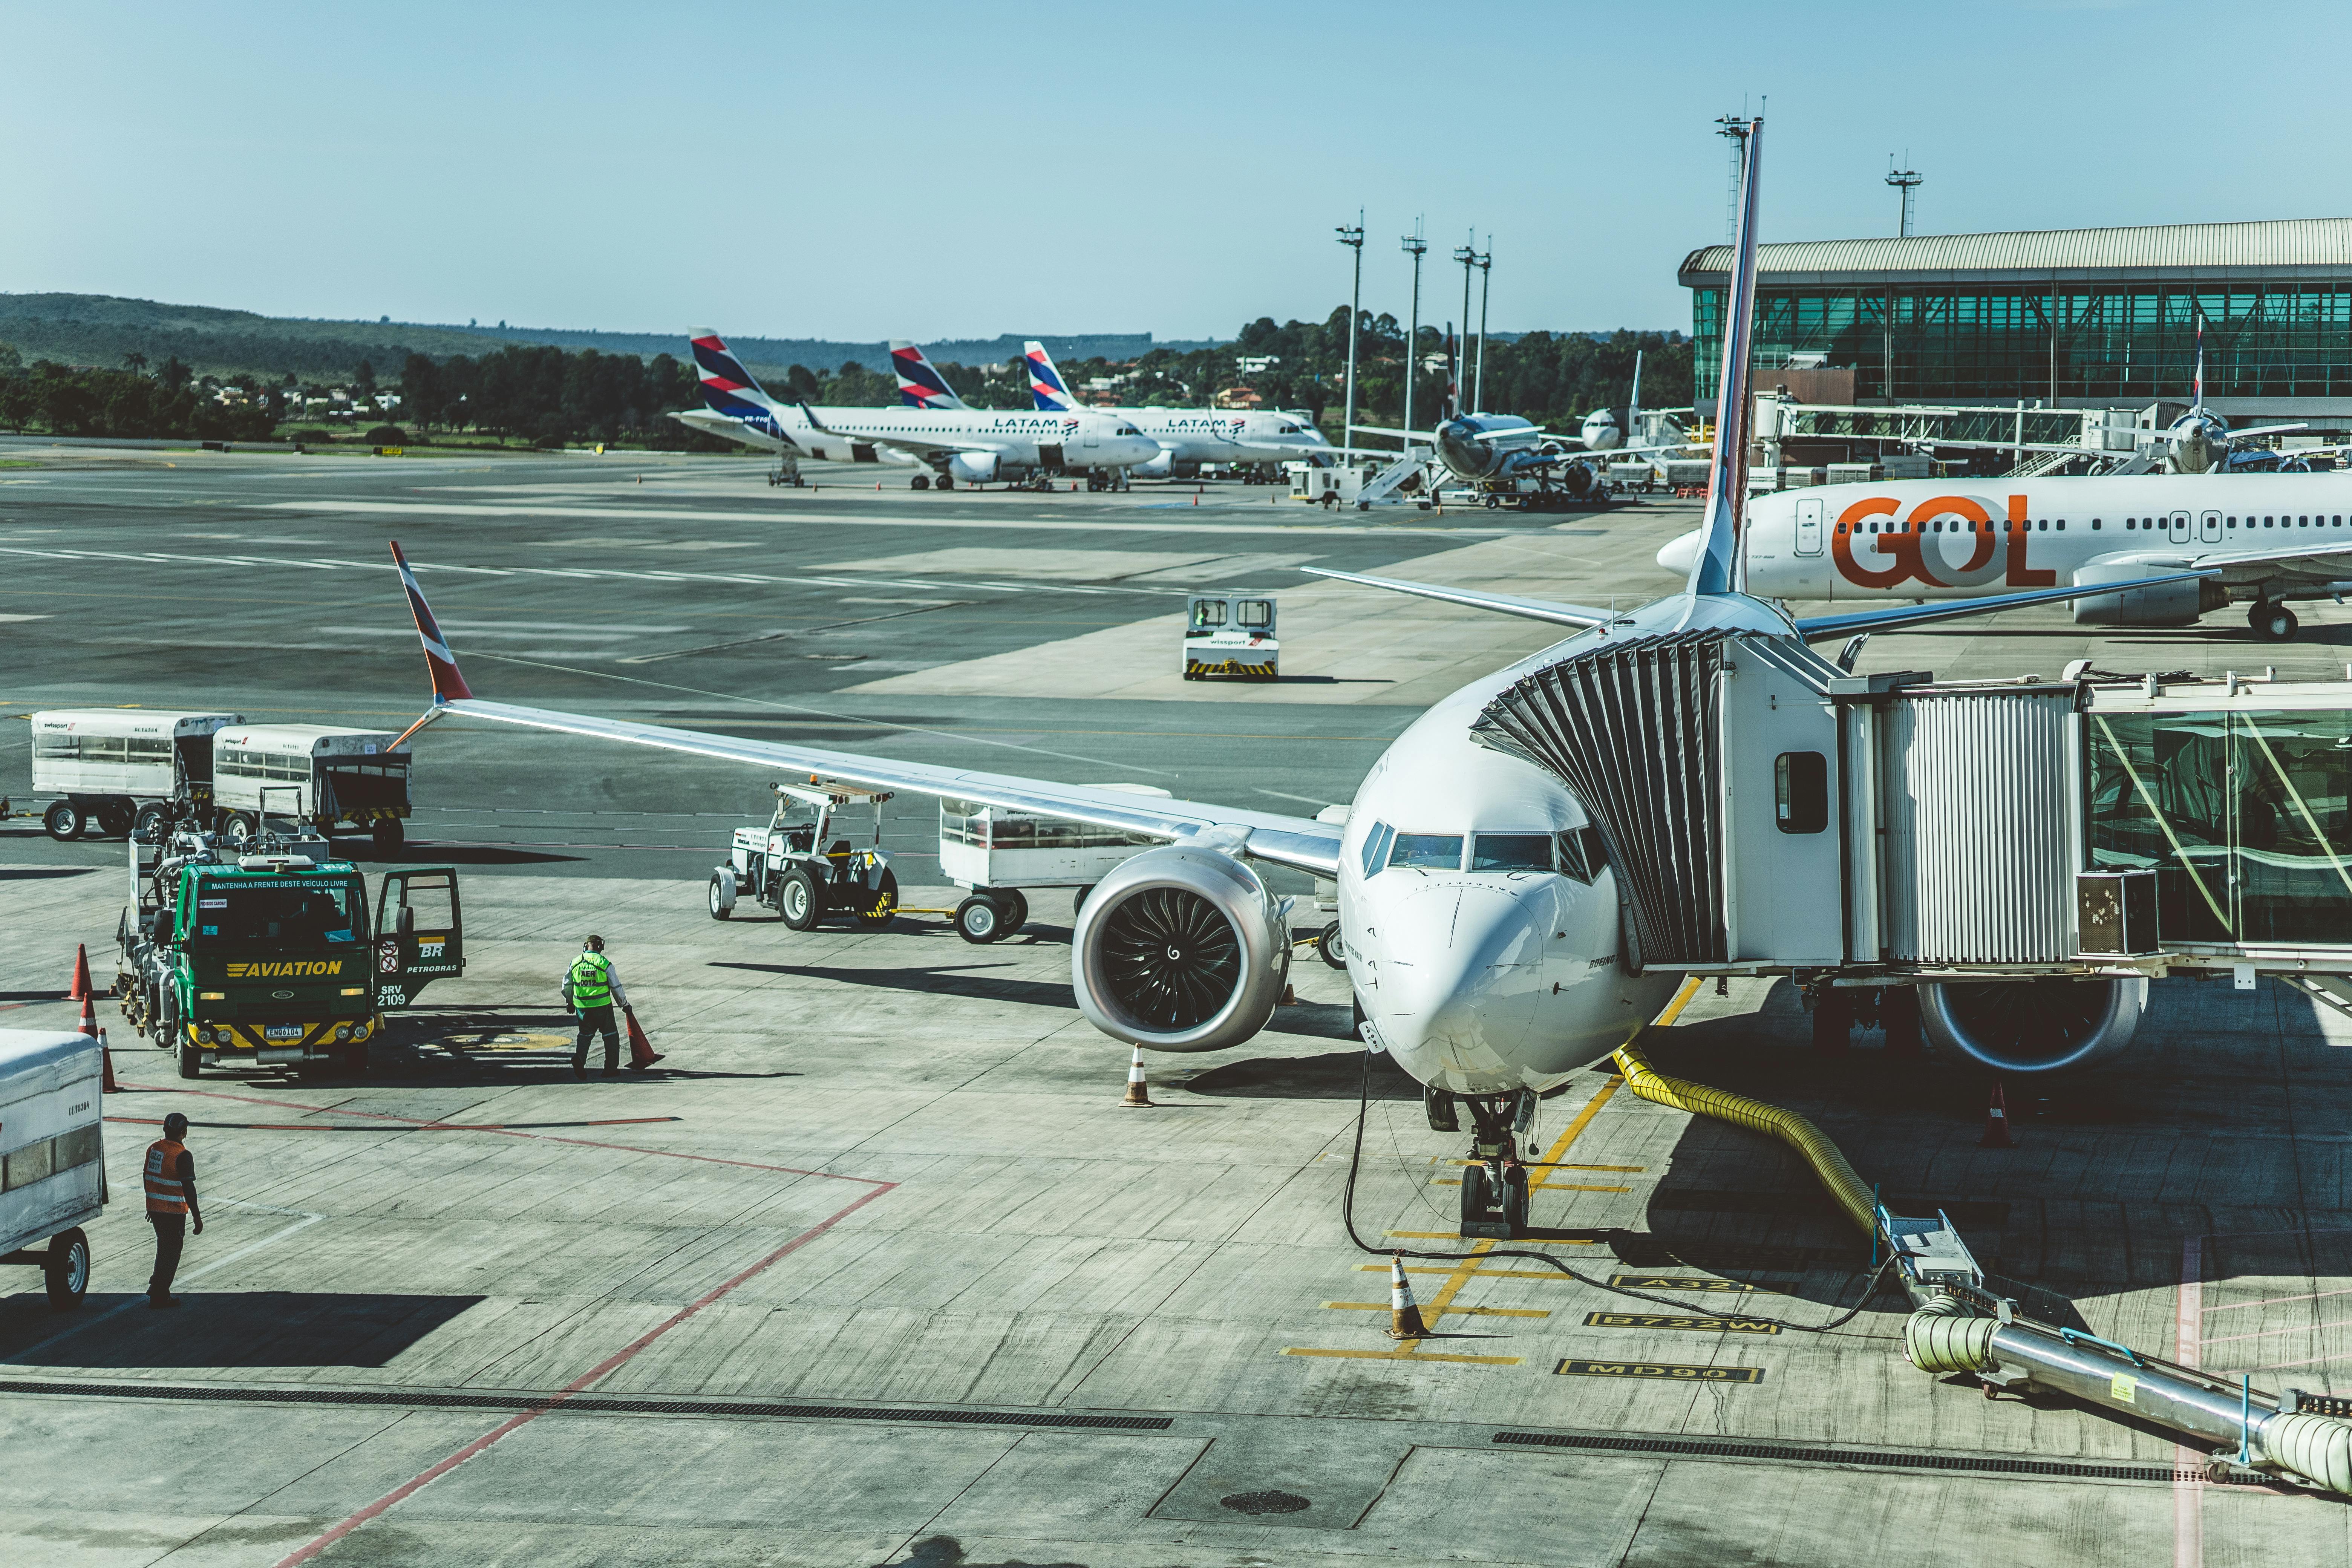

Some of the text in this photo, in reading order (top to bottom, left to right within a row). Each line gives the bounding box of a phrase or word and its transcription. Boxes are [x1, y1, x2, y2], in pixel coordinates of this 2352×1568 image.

[995, 418, 1057, 427] LATAM
[1832, 495, 2056, 588] GOL
[421, 945, 443, 958] BR
[1588, 954, 1615, 969] BOEING
[245, 960, 342, 977] AVIATION
[381, 985, 402, 994] SRV
[377, 994, 406, 1006] 2109
[1640, 1279, 1755, 1290] A321
[1588, 1364, 1727, 1378] MD90
